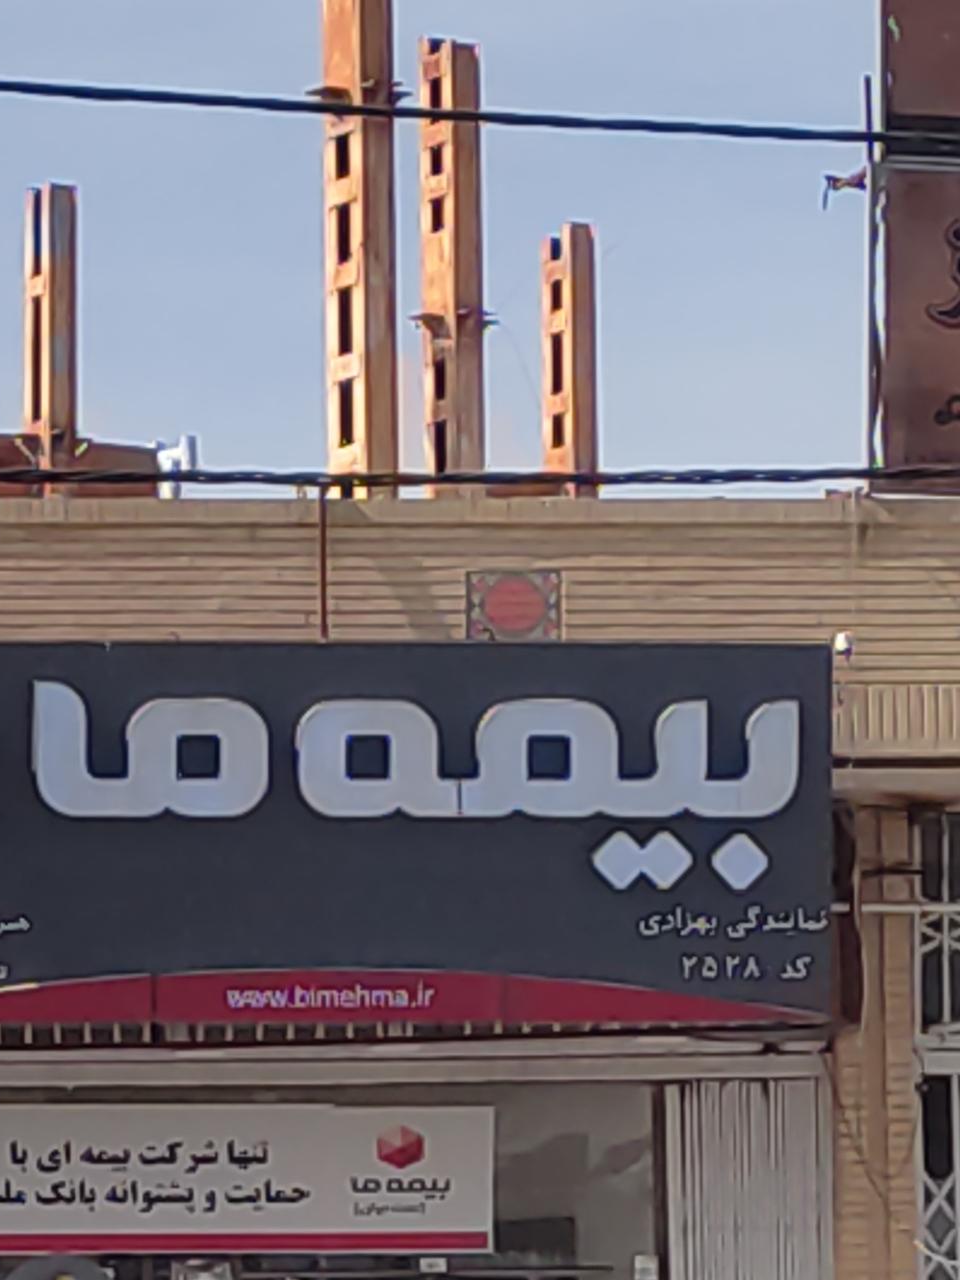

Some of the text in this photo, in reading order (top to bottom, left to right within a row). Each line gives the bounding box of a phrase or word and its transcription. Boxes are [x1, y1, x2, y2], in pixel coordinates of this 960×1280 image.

[32, 680, 801, 891] بیمه ما
[726, 905, 829, 938] نمایندگی
[681, 955, 812, 980] کد ۲۵۲۸
[225, 978, 435, 1009] www.bimehma.ir
[9, 1140, 268, 1174] تنها شرکت بیمه ای با
[35, 1180, 96, 1212] بانک
[104, 1180, 195, 1213] پشتوانه
[202, 1188, 217, 1213] و
[224, 1179, 311, 1212] حمایت
[350, 1176, 451, 1201] بیمه ما
